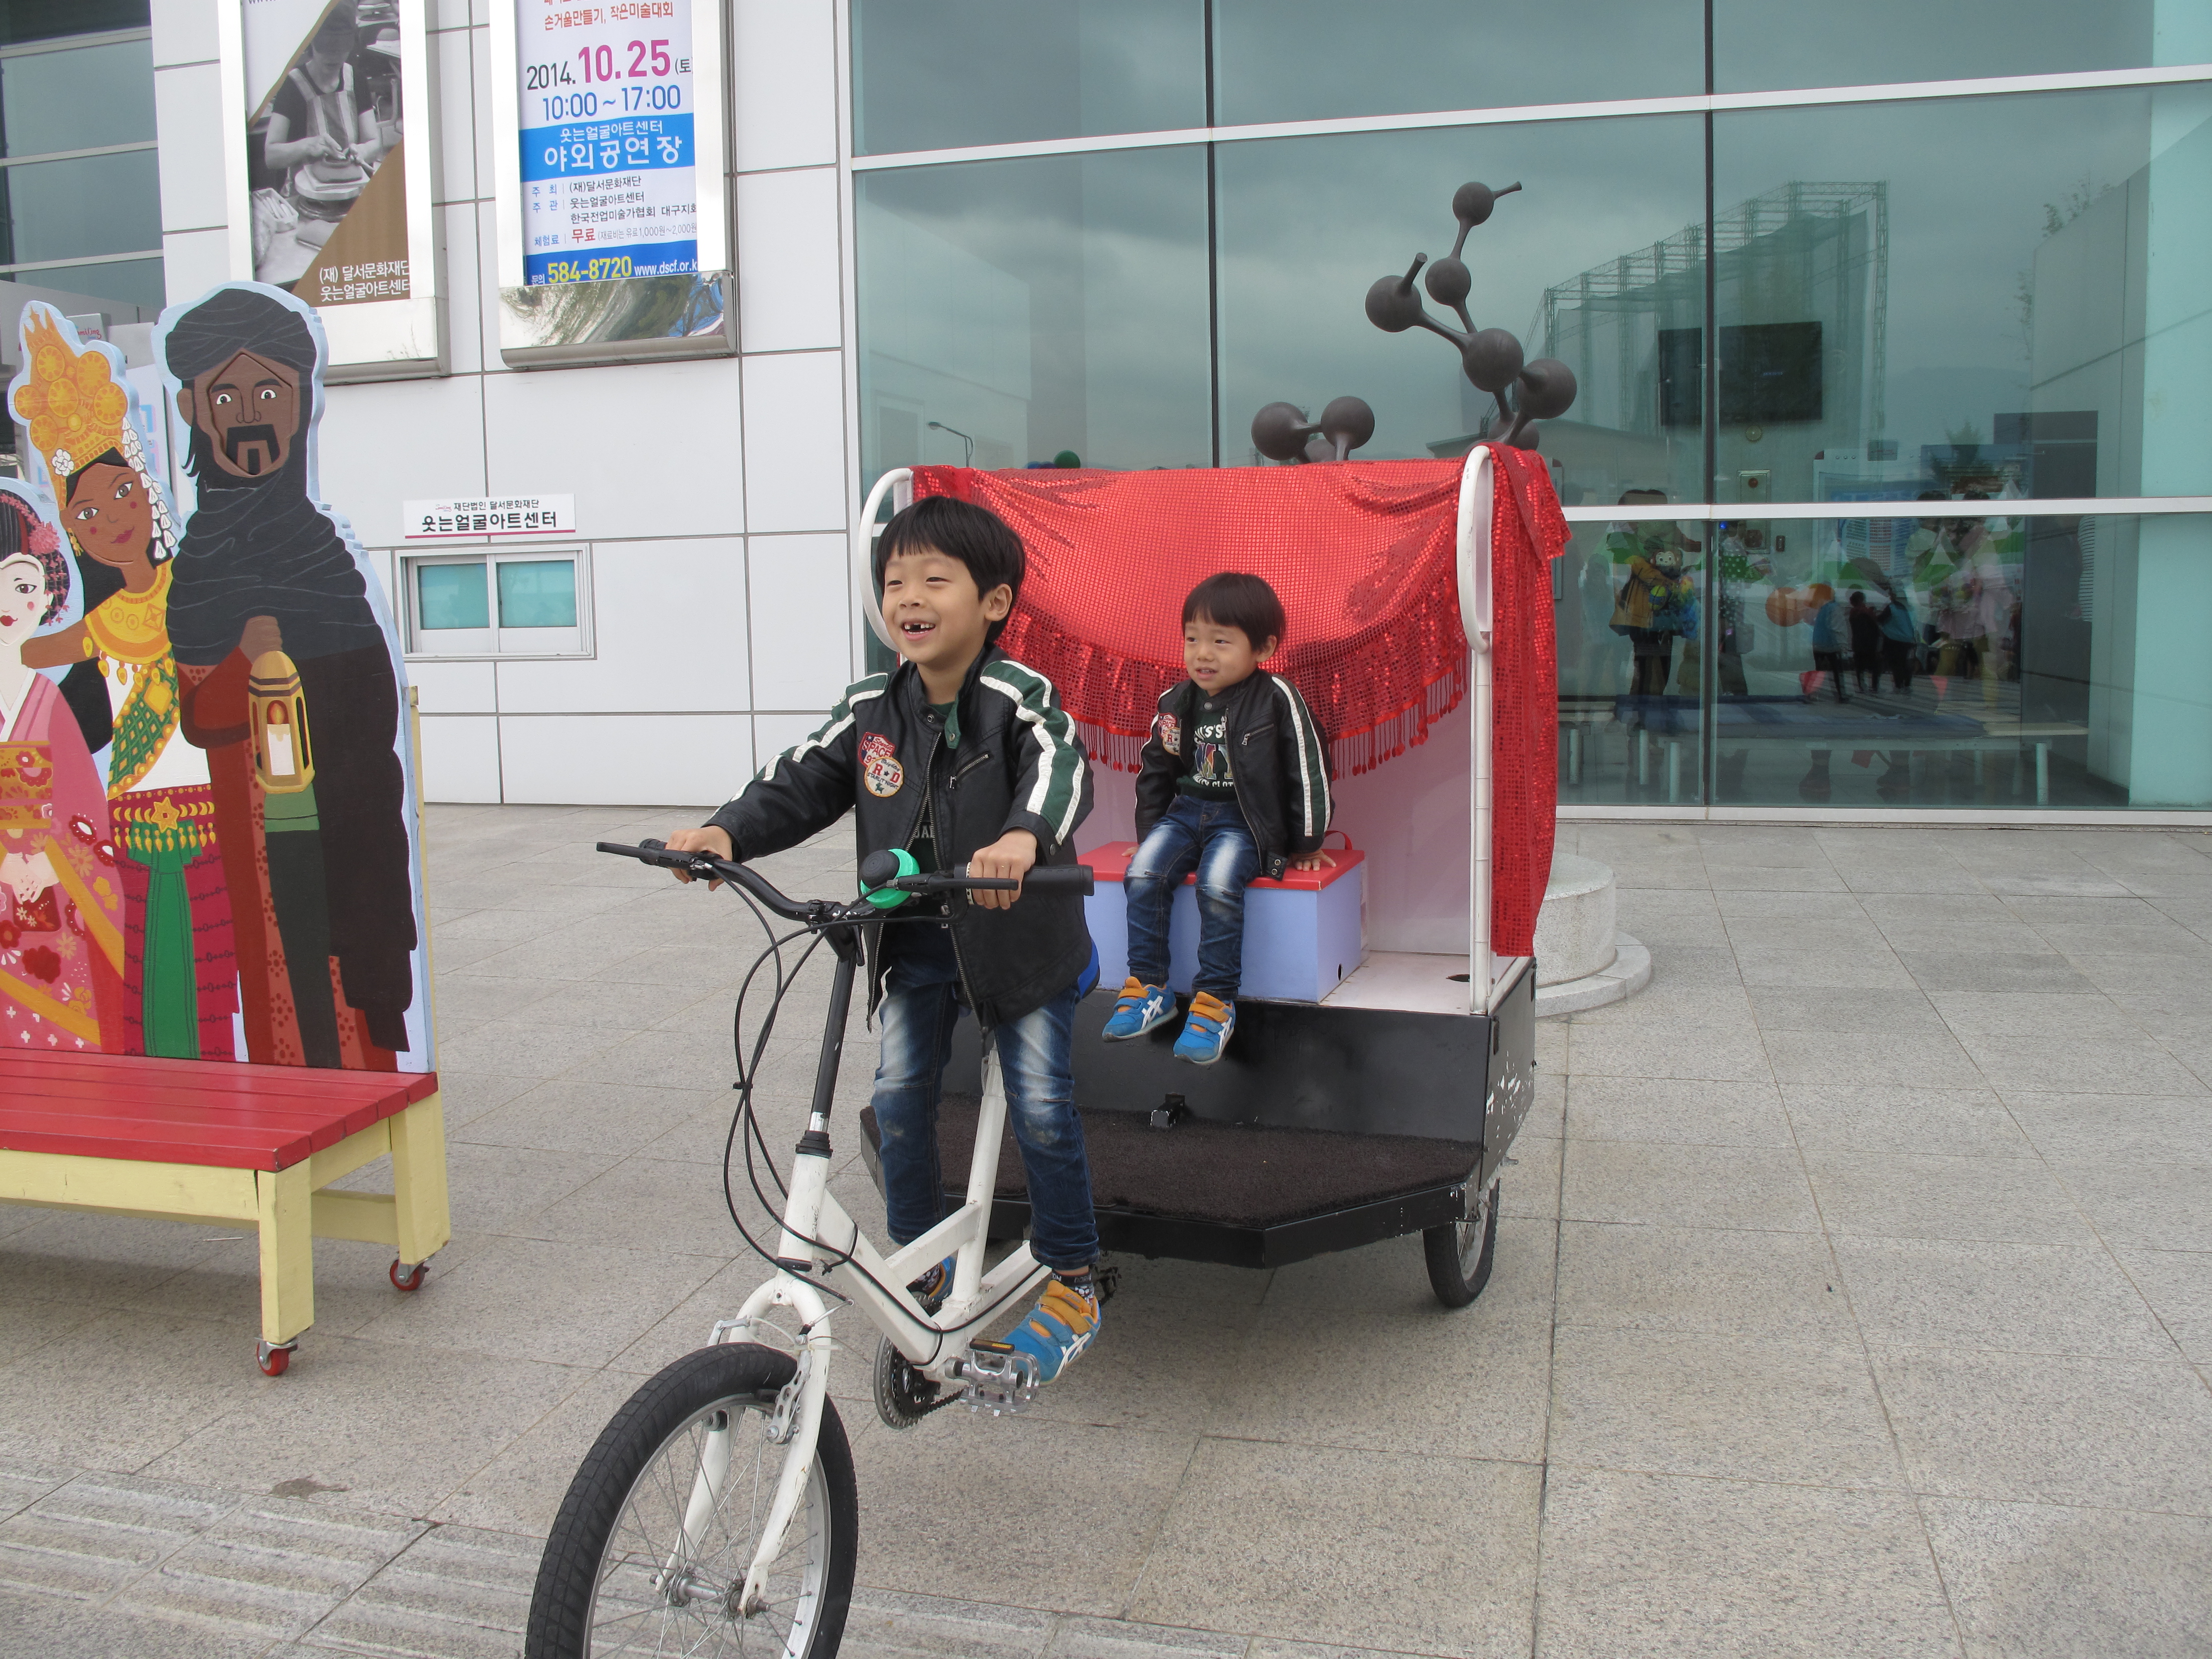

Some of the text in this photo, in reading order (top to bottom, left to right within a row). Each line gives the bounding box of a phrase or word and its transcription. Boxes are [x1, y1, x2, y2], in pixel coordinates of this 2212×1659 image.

[544, 1, 674, 31] 손거울만들기, 작은미술대회
[675, 56, 693, 76] (토
[560, 120, 663, 143] 웃는얼굴아트센터
[569, 175, 642, 194] (재)달서문화재단
[570, 191, 645, 210] 웃는얼굴아트센터
[571, 205, 656, 225] 한국전업미술가협회
[534, 234, 560, 247] 체험료
[571, 227, 596, 244] 무료
[319, 265, 339, 285] (재)
[547, 255, 633, 284] 584-8720
[453, 501, 487, 511] 재단법인
[489, 499, 540, 511] 달서문화재단
[422, 511, 558, 532] 웃는얼굴아트센터
[872, 762, 883, 776] R
